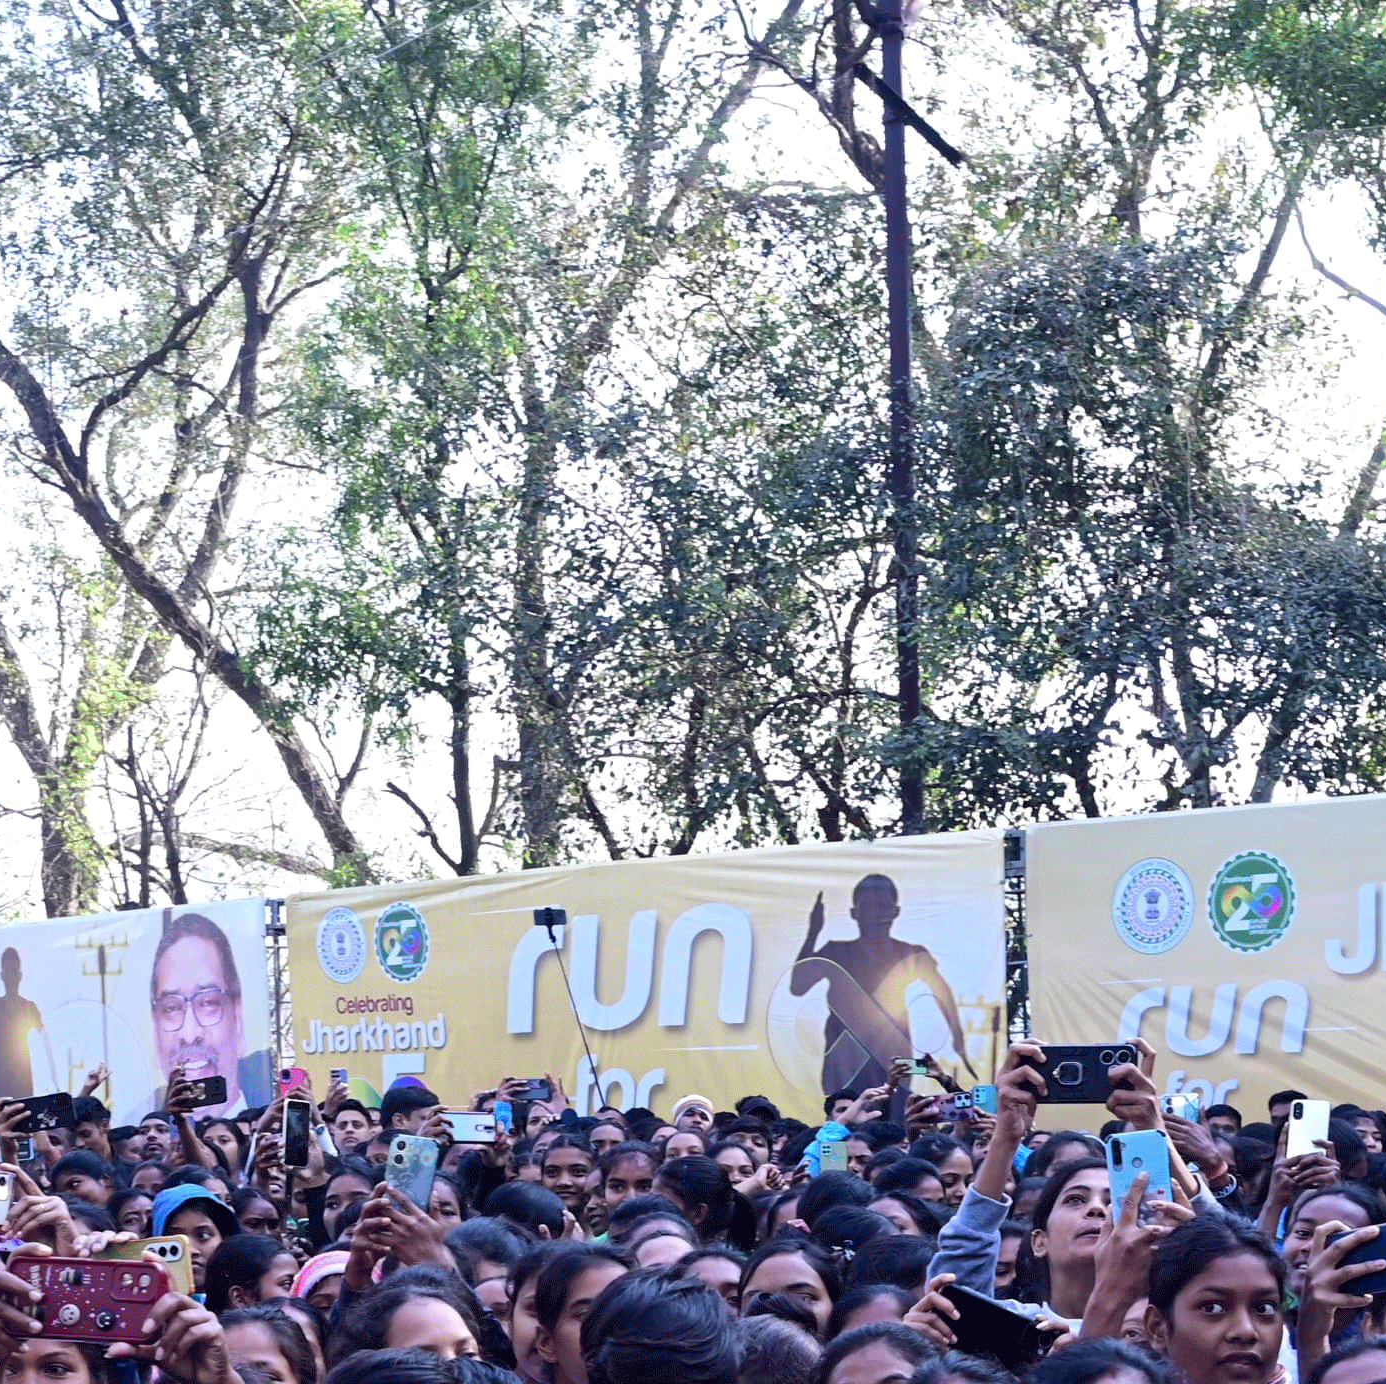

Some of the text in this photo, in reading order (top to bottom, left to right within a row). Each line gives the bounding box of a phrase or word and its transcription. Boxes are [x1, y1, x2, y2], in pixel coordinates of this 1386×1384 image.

[507, 904, 753, 1033] run
[302, 1013, 447, 1053] Jharkhand
[336, 994, 413, 1015] Celebrating
[1117, 980, 1309, 1057] run
